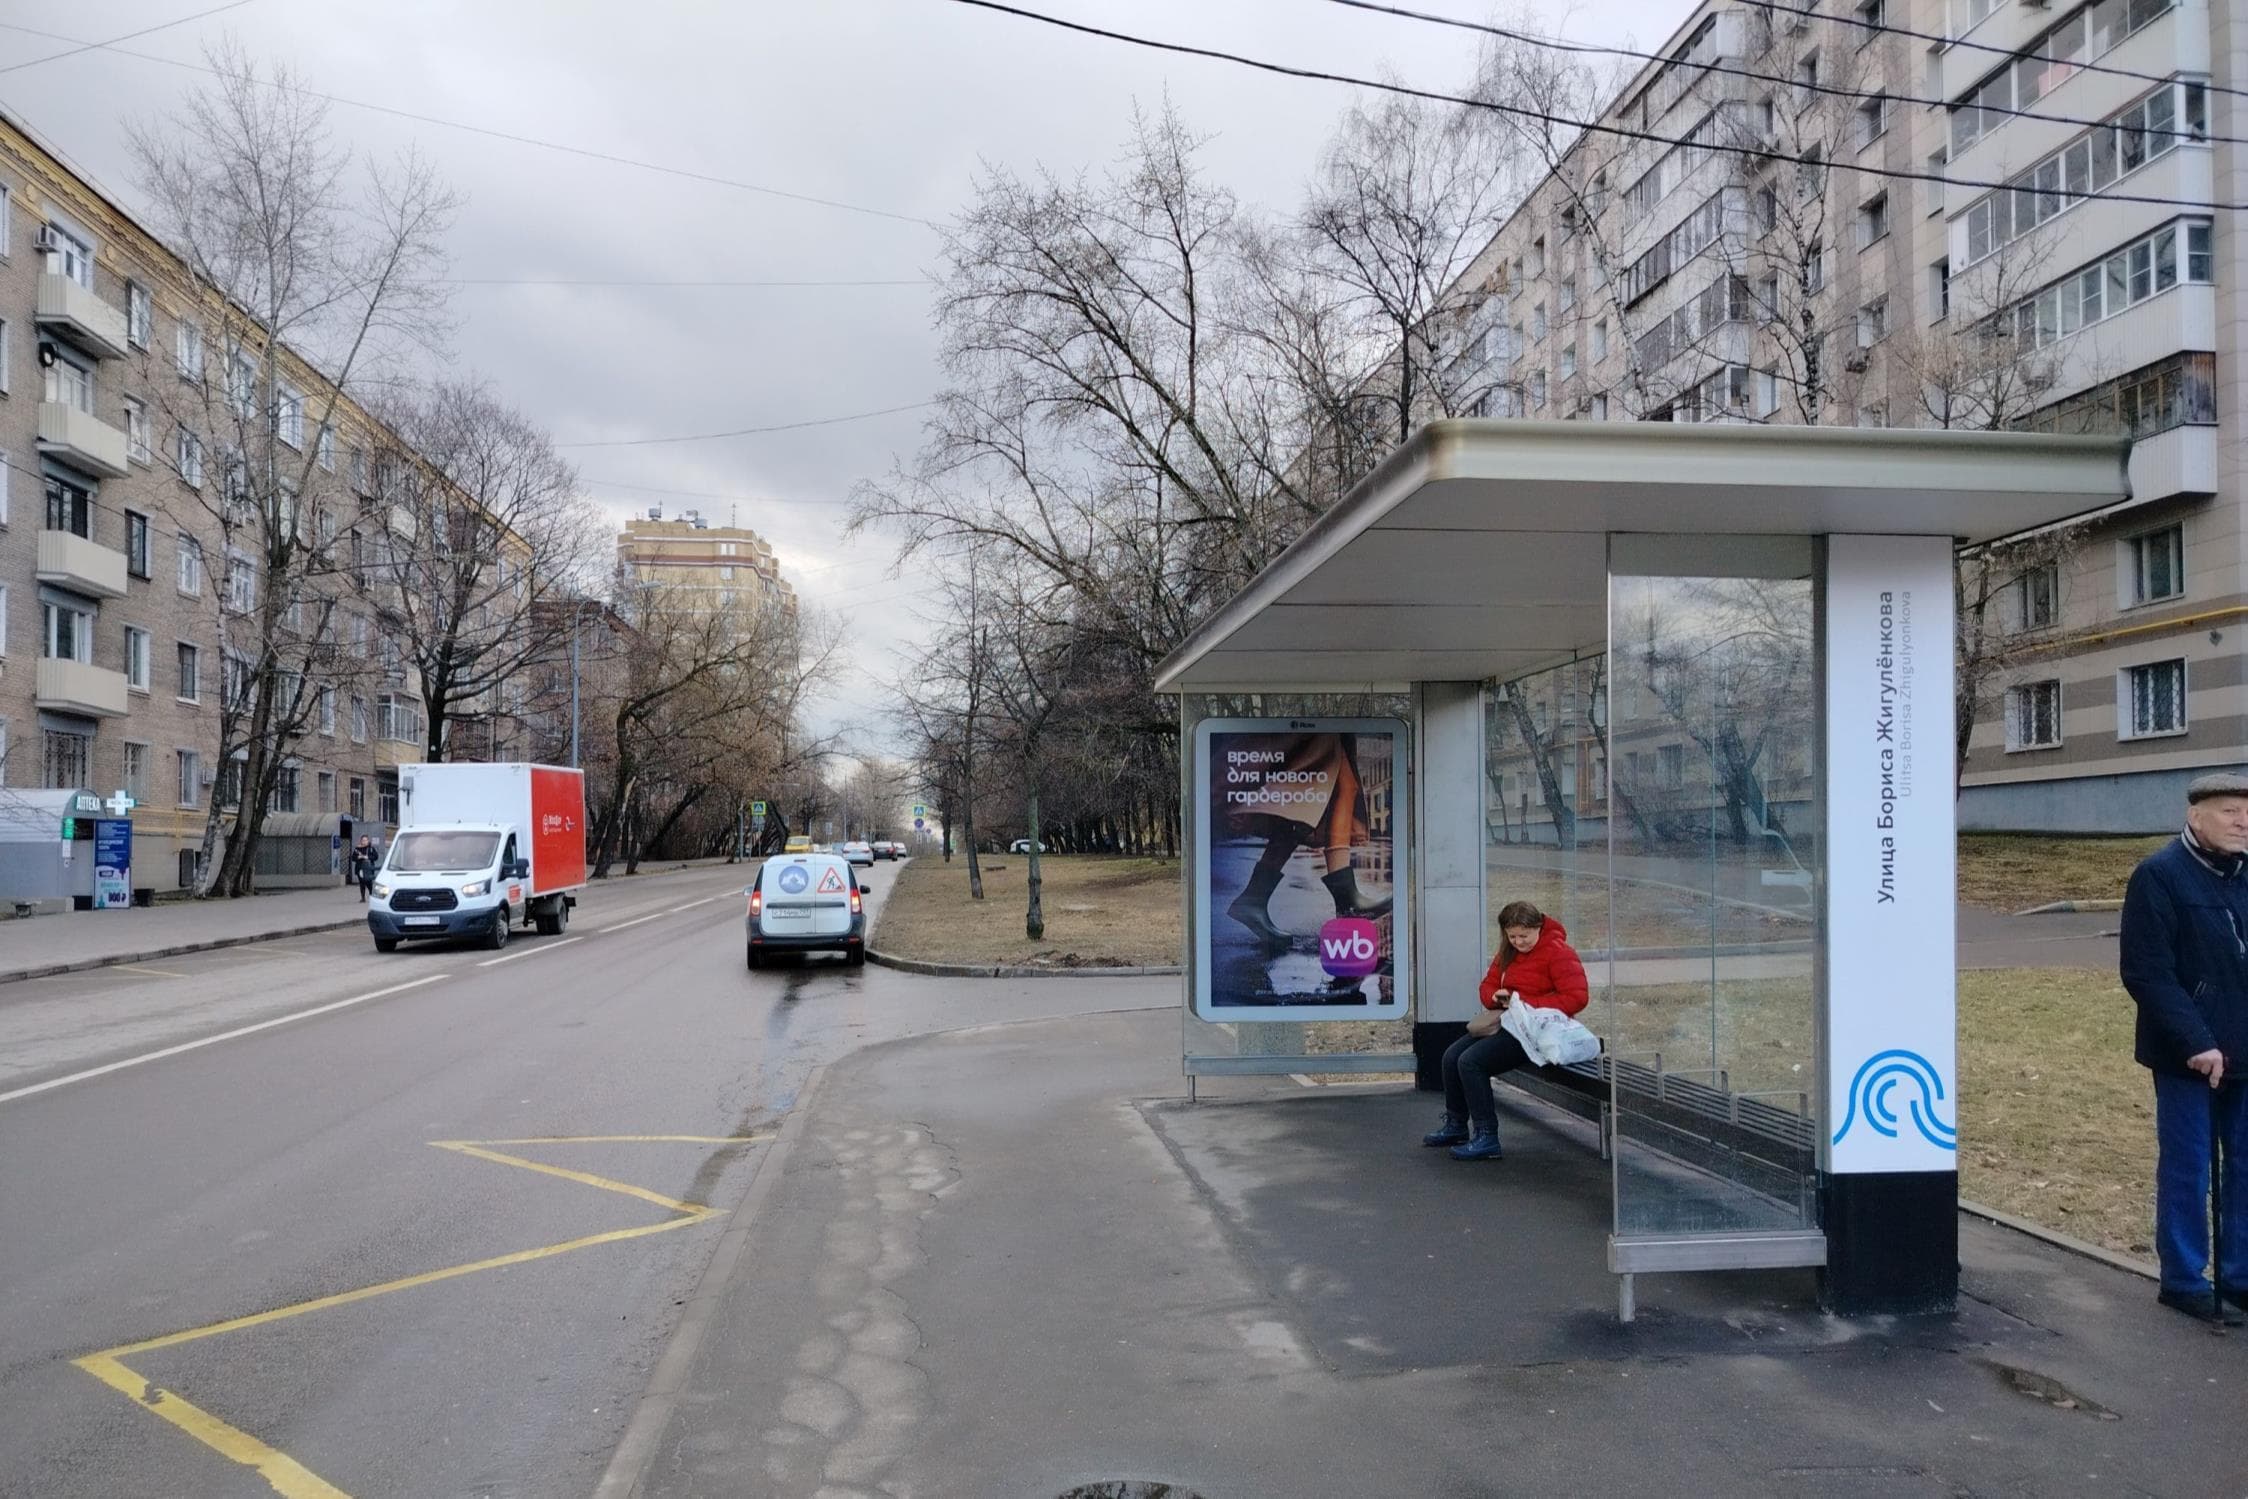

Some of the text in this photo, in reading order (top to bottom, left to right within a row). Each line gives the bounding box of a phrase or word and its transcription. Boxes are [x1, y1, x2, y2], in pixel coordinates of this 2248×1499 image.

[1899, 591, 1914, 797] Ulitsa Borisa Zhigulyonkova
[1876, 591, 1898, 904] Улица Бориса Жигулёнкова
[1227, 751, 1285, 767] время
[1226, 766, 1328, 783] для нового
[76, 795, 101, 811] АПТЕКА
[1227, 786, 1328, 806] гардероба
[1323, 930, 1374, 960] wb
